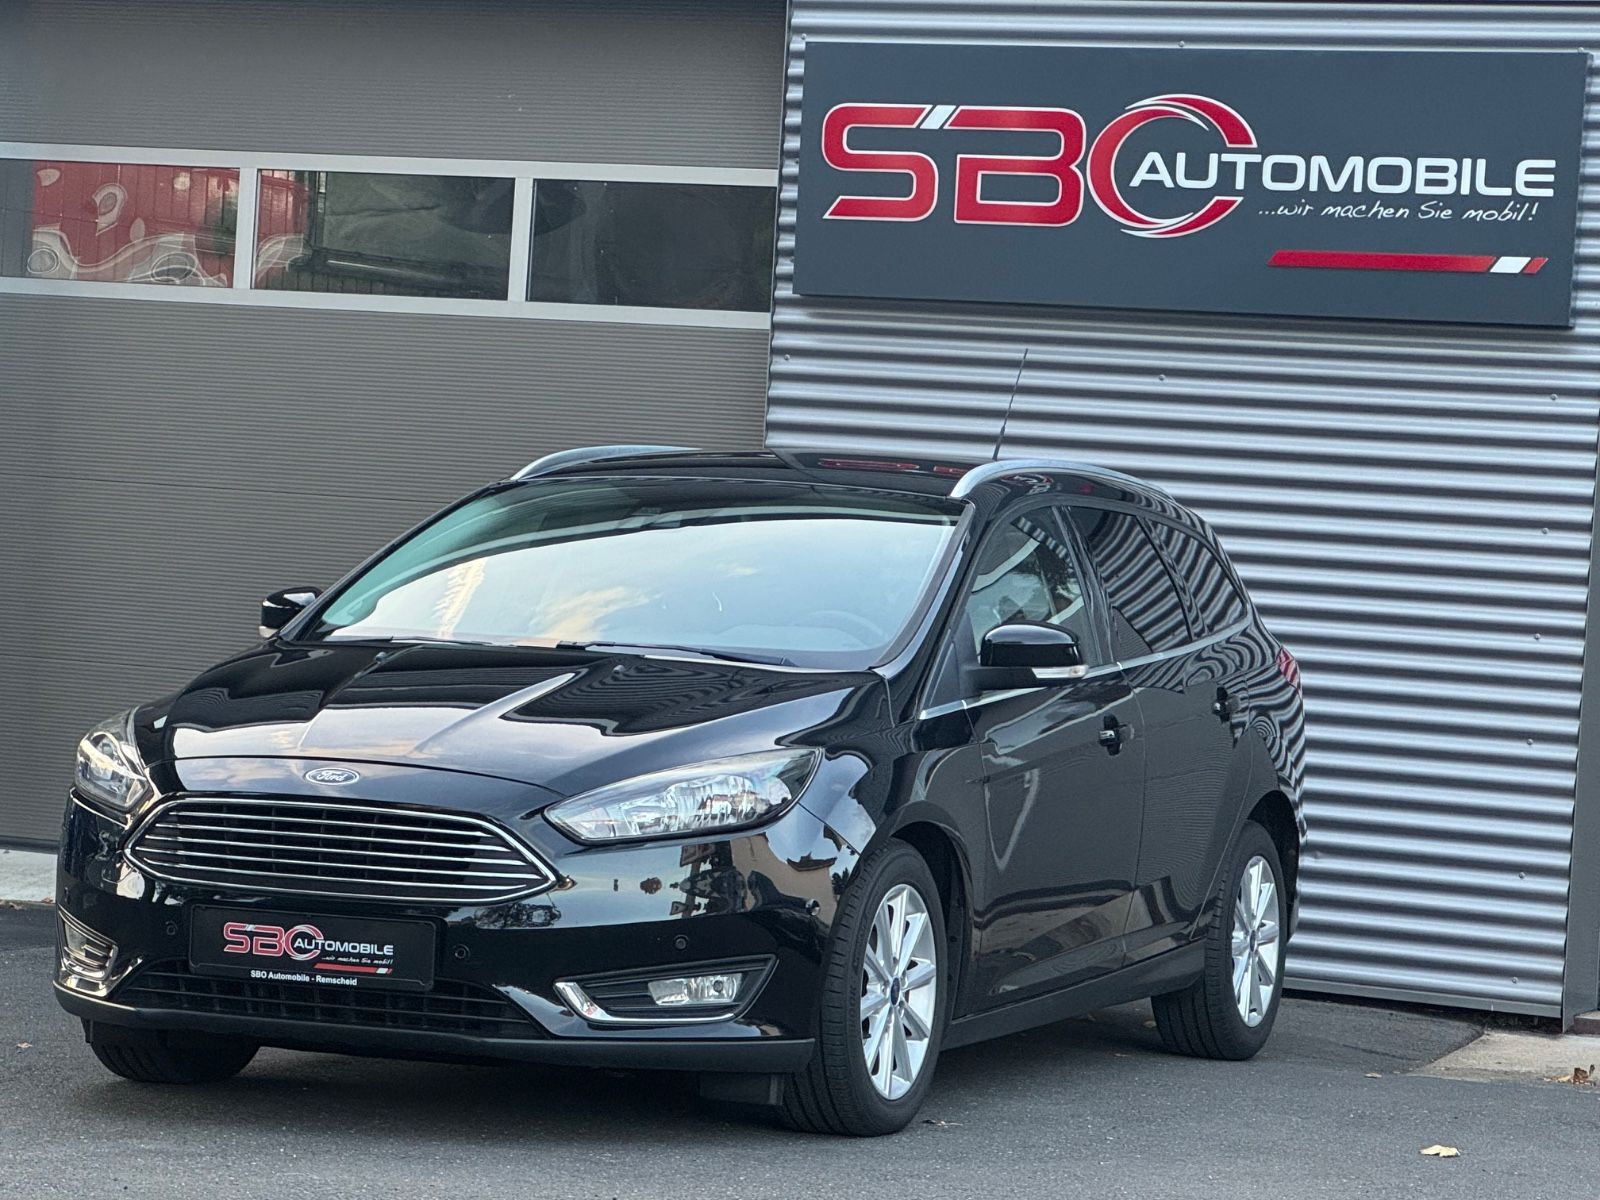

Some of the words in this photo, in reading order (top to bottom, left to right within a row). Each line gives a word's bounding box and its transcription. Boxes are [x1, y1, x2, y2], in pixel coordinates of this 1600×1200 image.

[1129, 152, 1556, 197] AUTOMOBILE
[1321, 200, 1409, 219] machen
[1418, 201, 1453, 219] Sie
[1462, 201, 1539, 222] mobil!
[316, 769, 348, 782] Ford
[293, 937, 394, 956] AUTOMOBILE
[250, 969, 267, 979] SBO
[268, 971, 310, 982] Automobile
[316, 975, 358, 986] Remscheid
